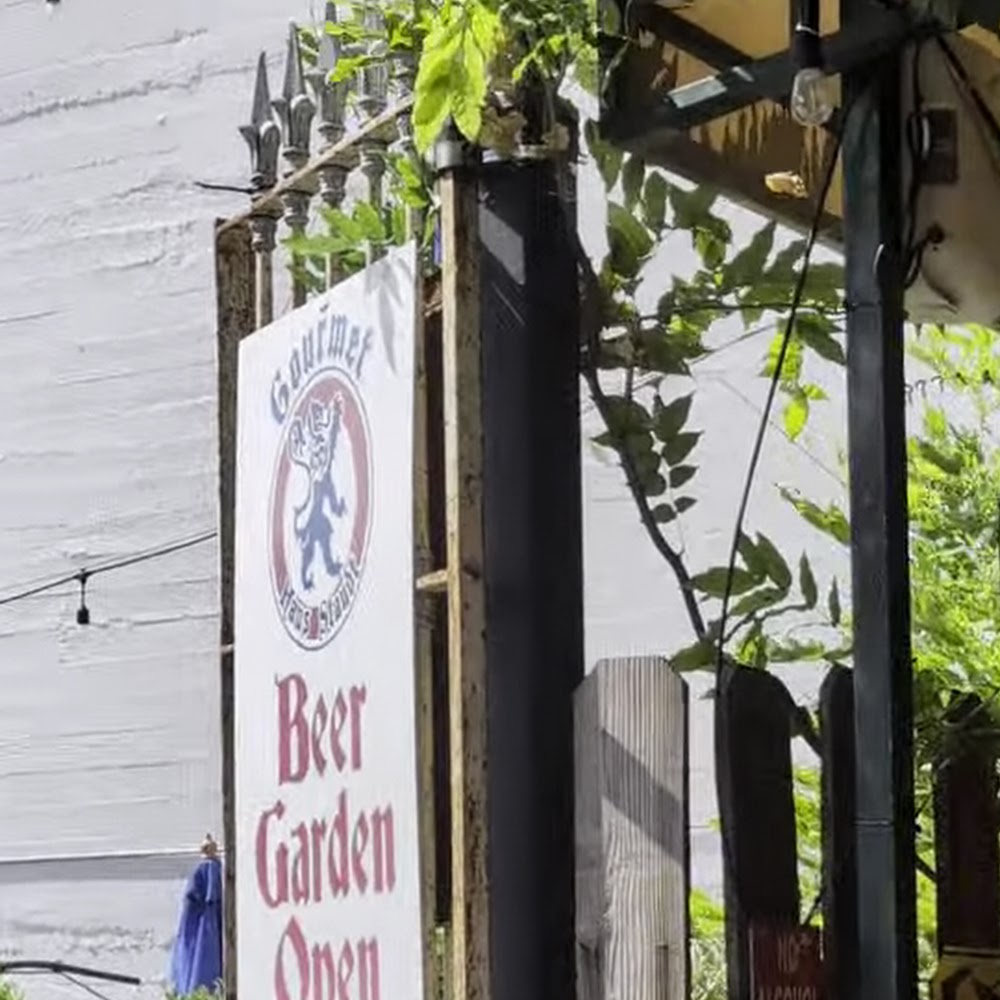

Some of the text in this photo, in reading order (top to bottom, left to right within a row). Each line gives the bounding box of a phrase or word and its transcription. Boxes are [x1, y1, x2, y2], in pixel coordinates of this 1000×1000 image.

[271, 314, 374, 425] Gourmet
[276, 672, 367, 787] Beer
[255, 788, 397, 909] Garden
[777, 939, 798, 975] NO
